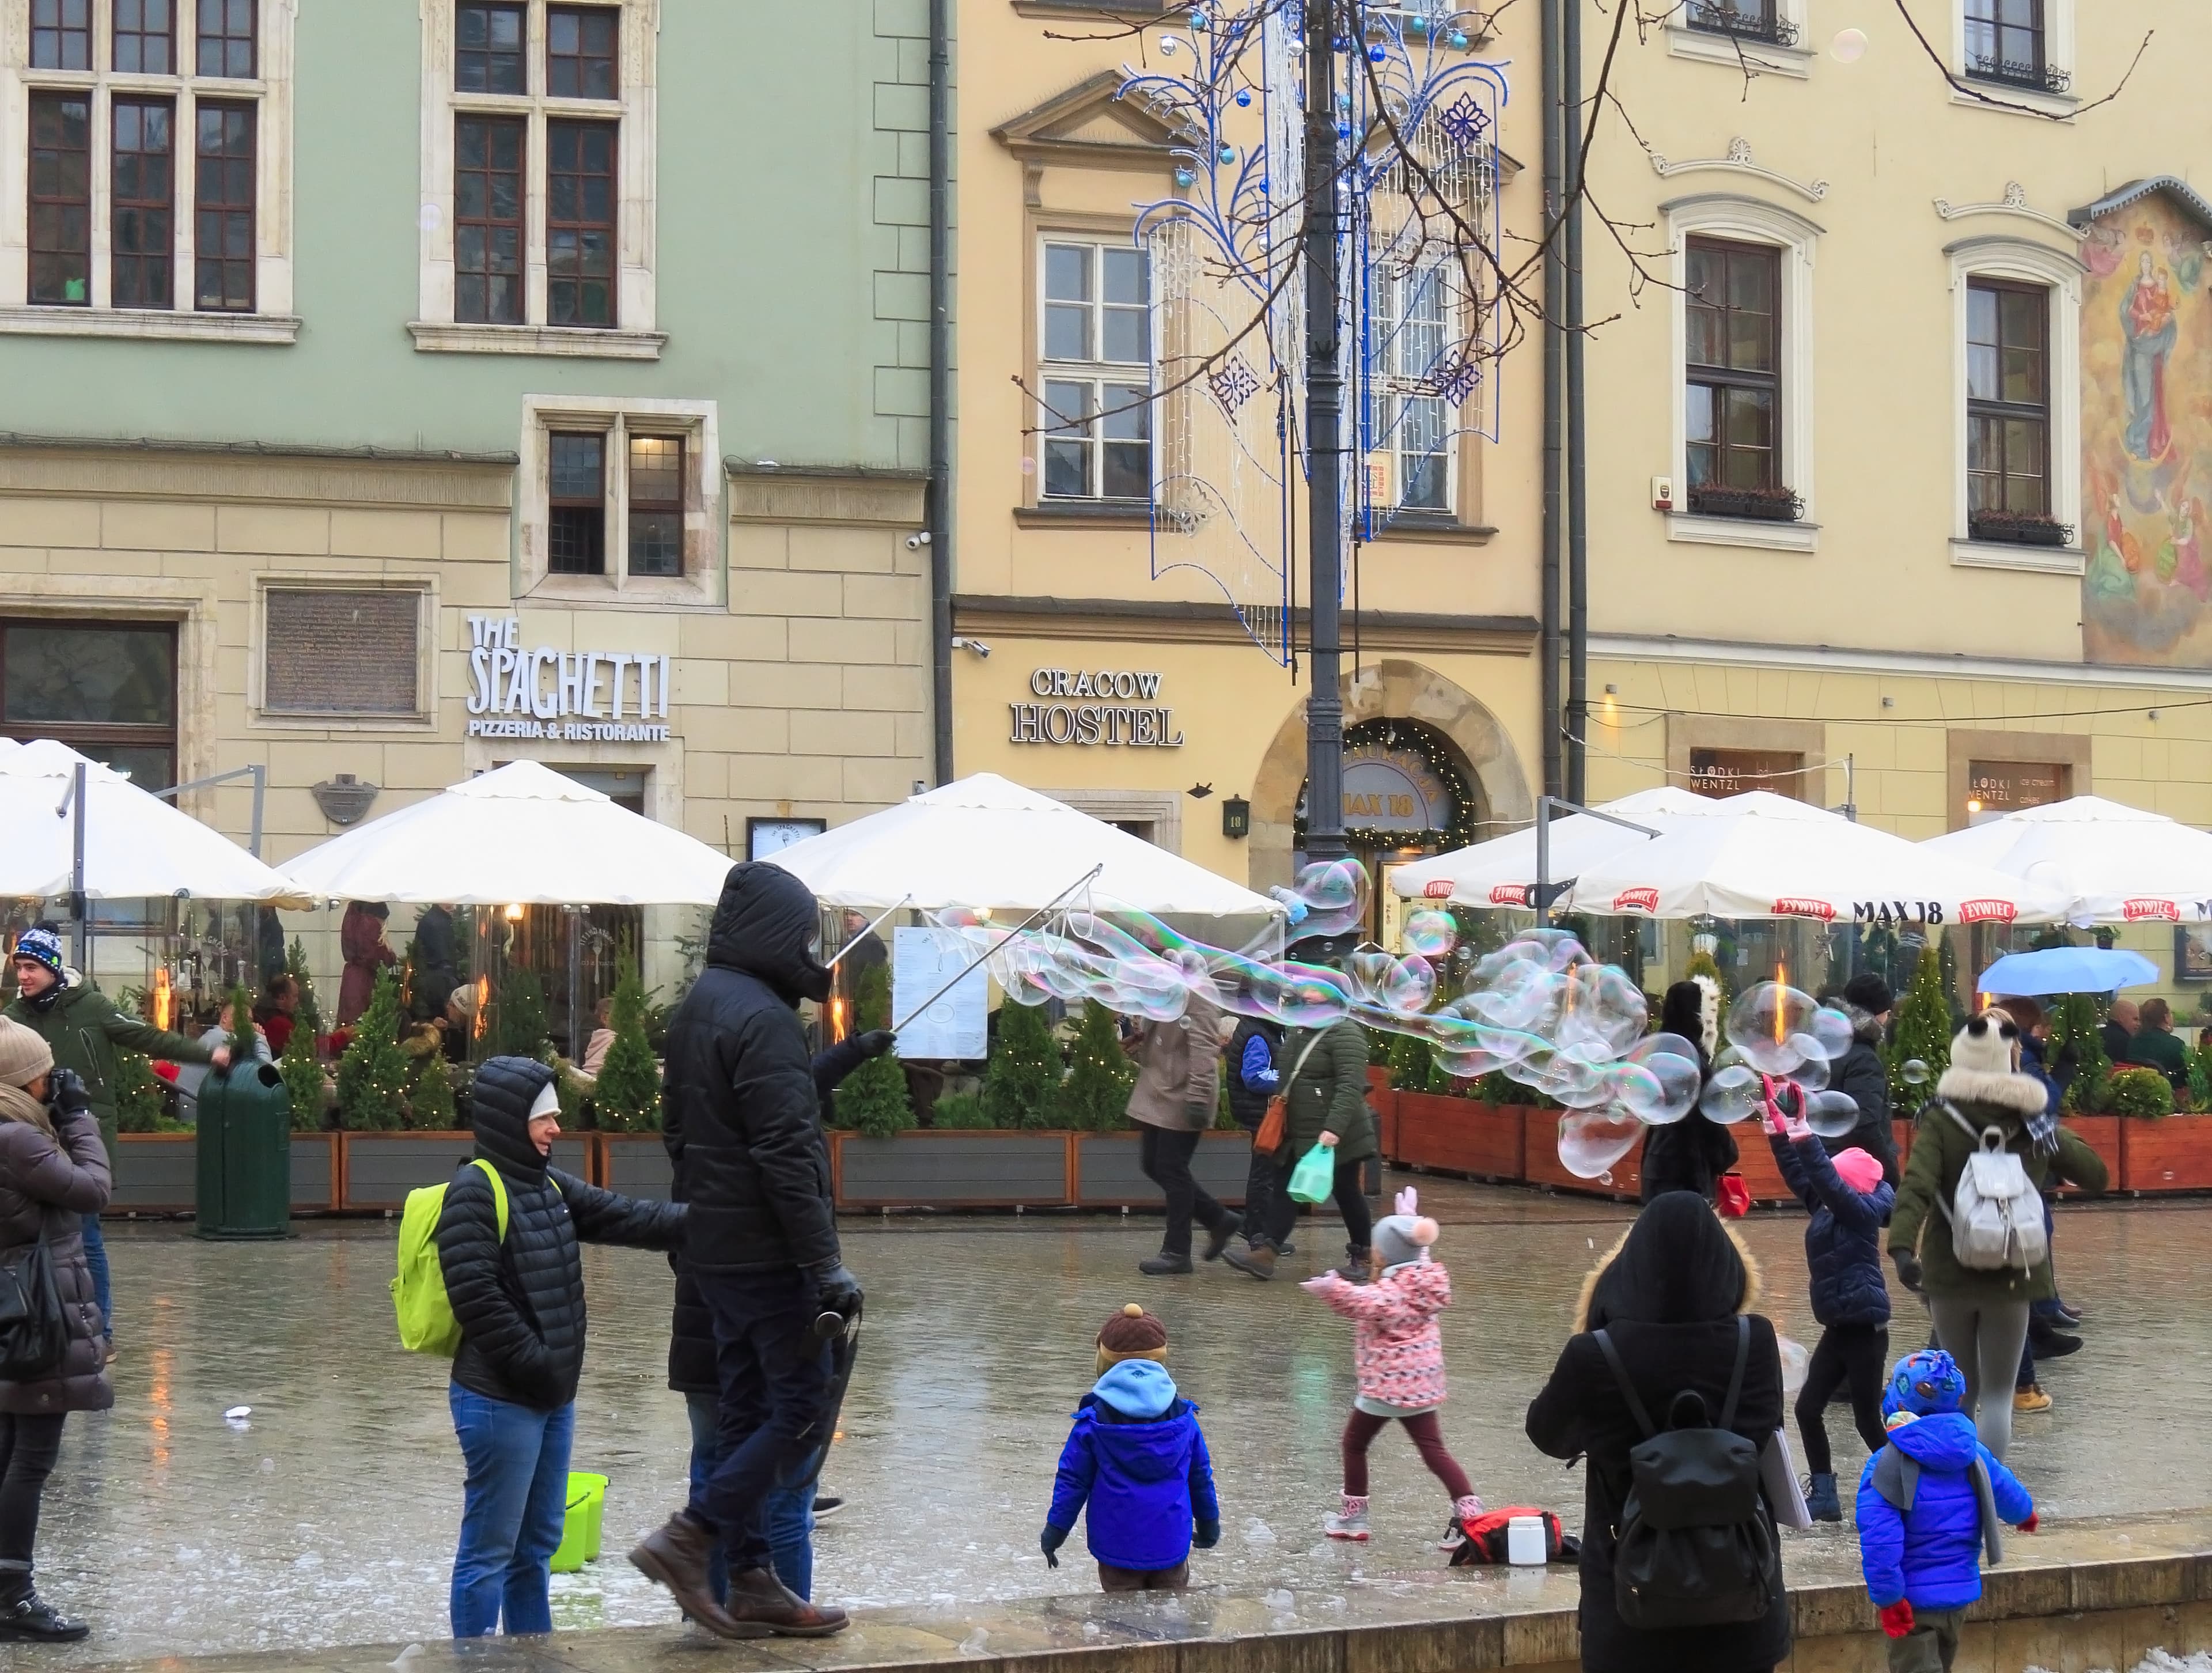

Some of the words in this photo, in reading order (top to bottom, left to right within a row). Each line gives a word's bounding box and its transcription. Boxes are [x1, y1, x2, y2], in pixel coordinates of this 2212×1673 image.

[466, 615, 519, 649] THE
[466, 646, 671, 720] SPAGHETTI
[1031, 668, 1164, 699] CRACOW
[468, 719, 543, 739] PIZZERIA
[547, 722, 560, 740] &
[564, 722, 671, 742] RISTORANTE
[1010, 702, 1185, 747] HOSTEL
[1691, 778, 1740, 791] WENTZL
[1973, 777, 2010, 789] ŁODKI
[1230, 816, 1241, 828] 18
[1781, 898, 1828, 916] ŻYWIEC
[1853, 902, 1910, 922] MAX
[1915, 902, 1944, 924] 18
[1965, 902, 2010, 918] ŻYWIEC
[2128, 900, 2172, 915] ŻYWIEC
